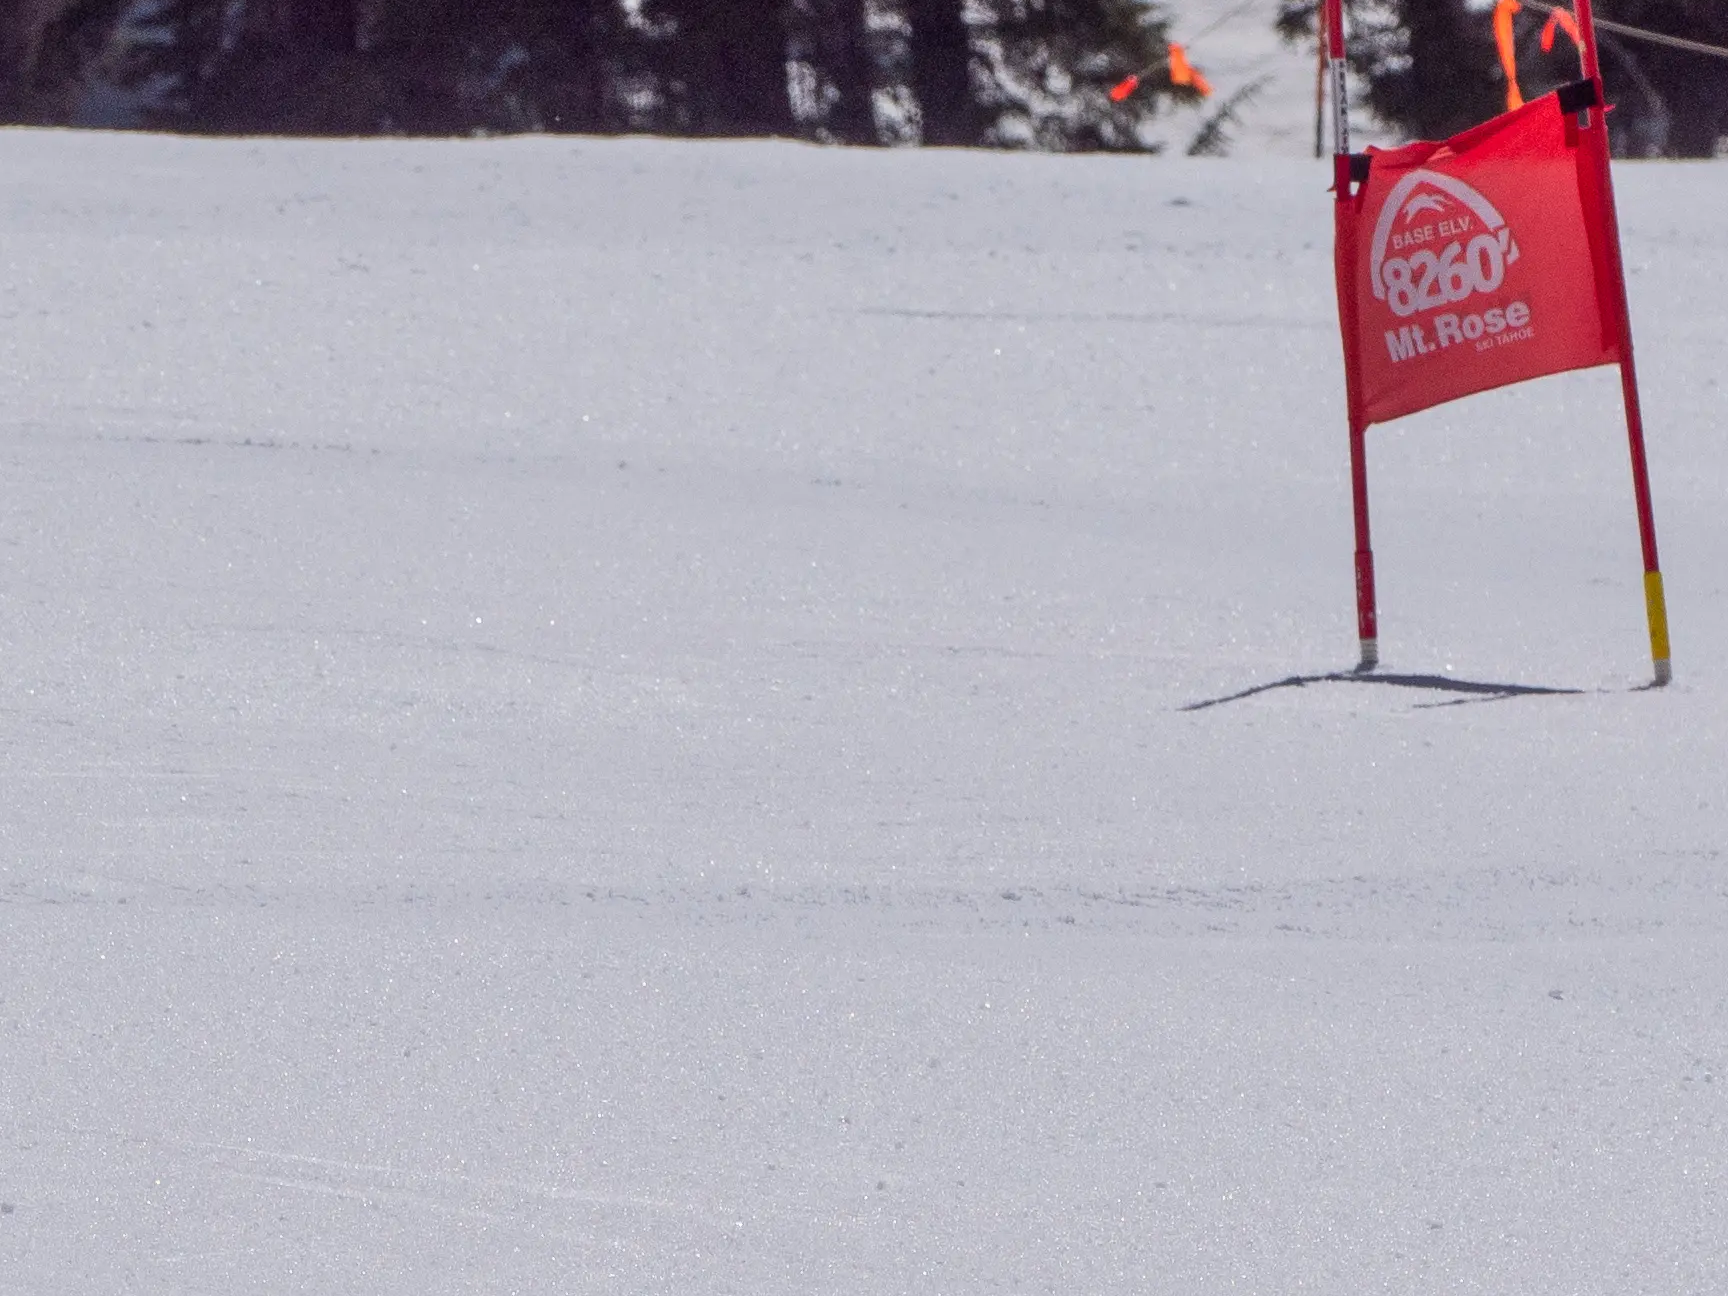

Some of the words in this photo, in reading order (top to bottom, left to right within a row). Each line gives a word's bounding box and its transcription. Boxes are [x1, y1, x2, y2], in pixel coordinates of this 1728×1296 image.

[1392, 225, 1434, 249] BASE
[1383, 228, 1510, 318] 8260'
[1384, 324, 1437, 363] Mt.
[1434, 301, 1531, 348] Rose
